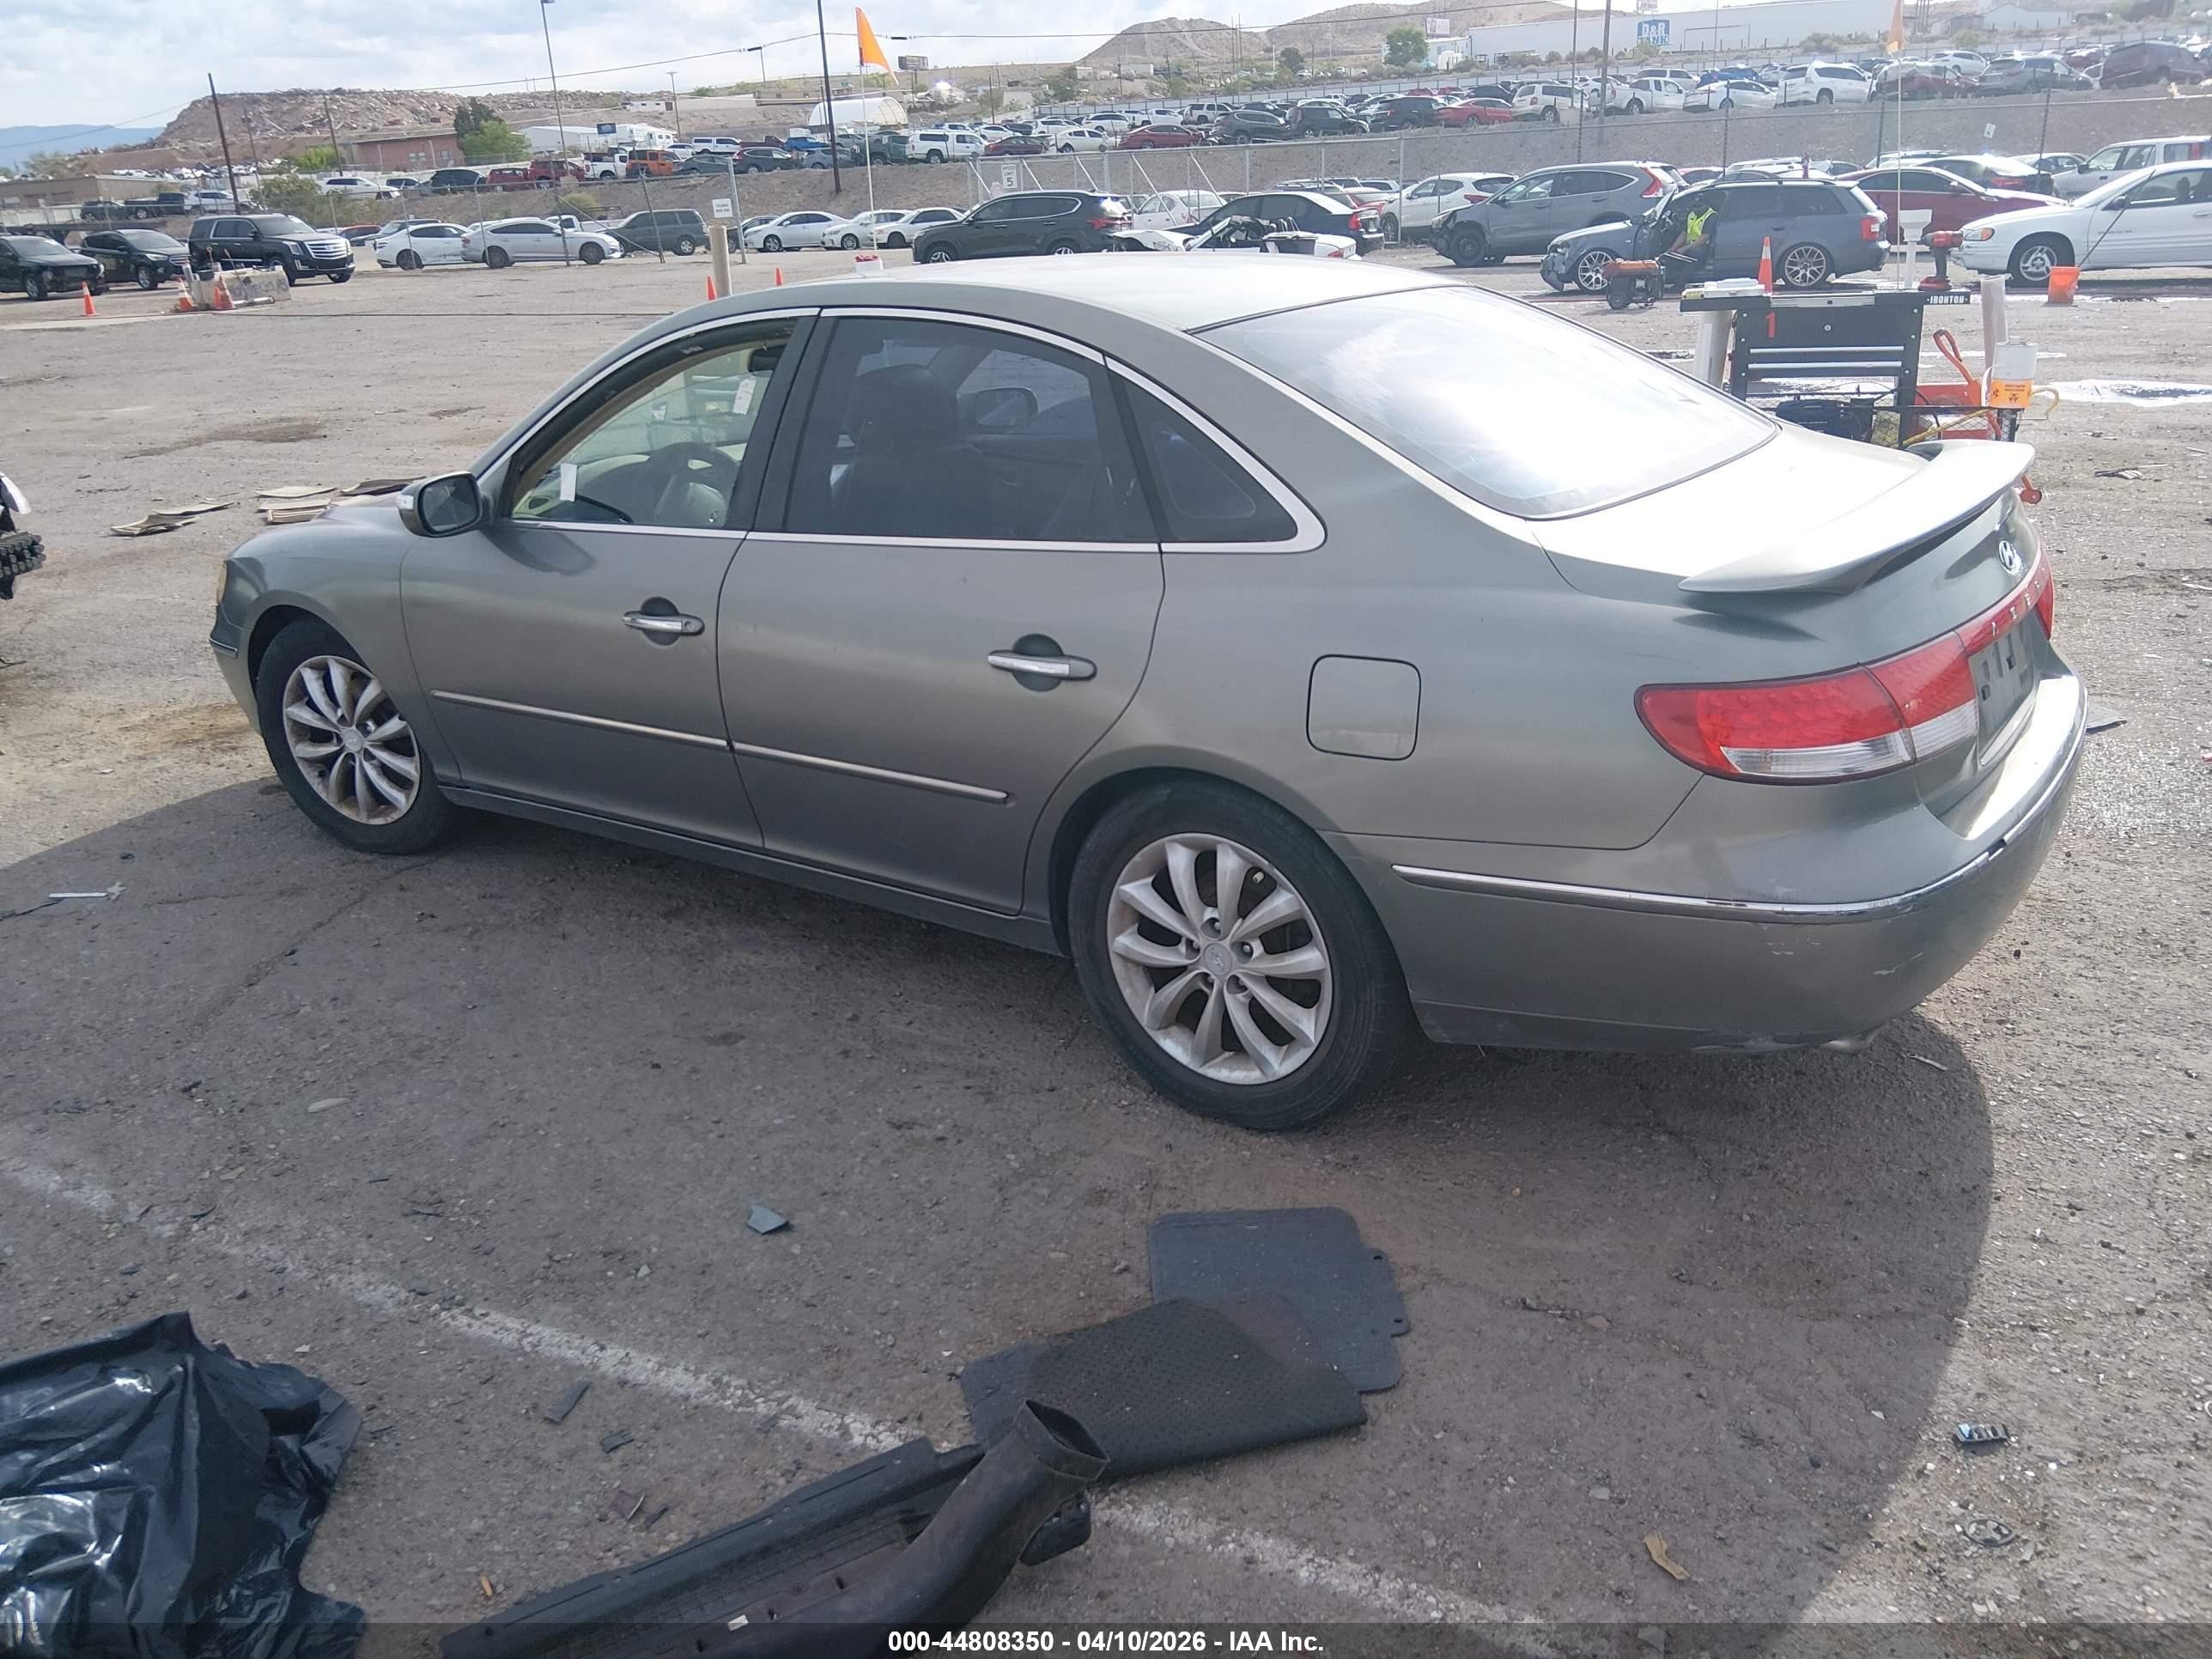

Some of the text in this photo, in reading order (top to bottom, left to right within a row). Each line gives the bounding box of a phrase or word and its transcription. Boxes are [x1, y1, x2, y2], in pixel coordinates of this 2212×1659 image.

[1642, 22, 1666, 37] D&R
[1006, 177, 1013, 186] 5
[1929, 295, 1965, 304] IRONTON
[1765, 311, 1776, 338] 1
[1991, 567, 2045, 636] AZE
